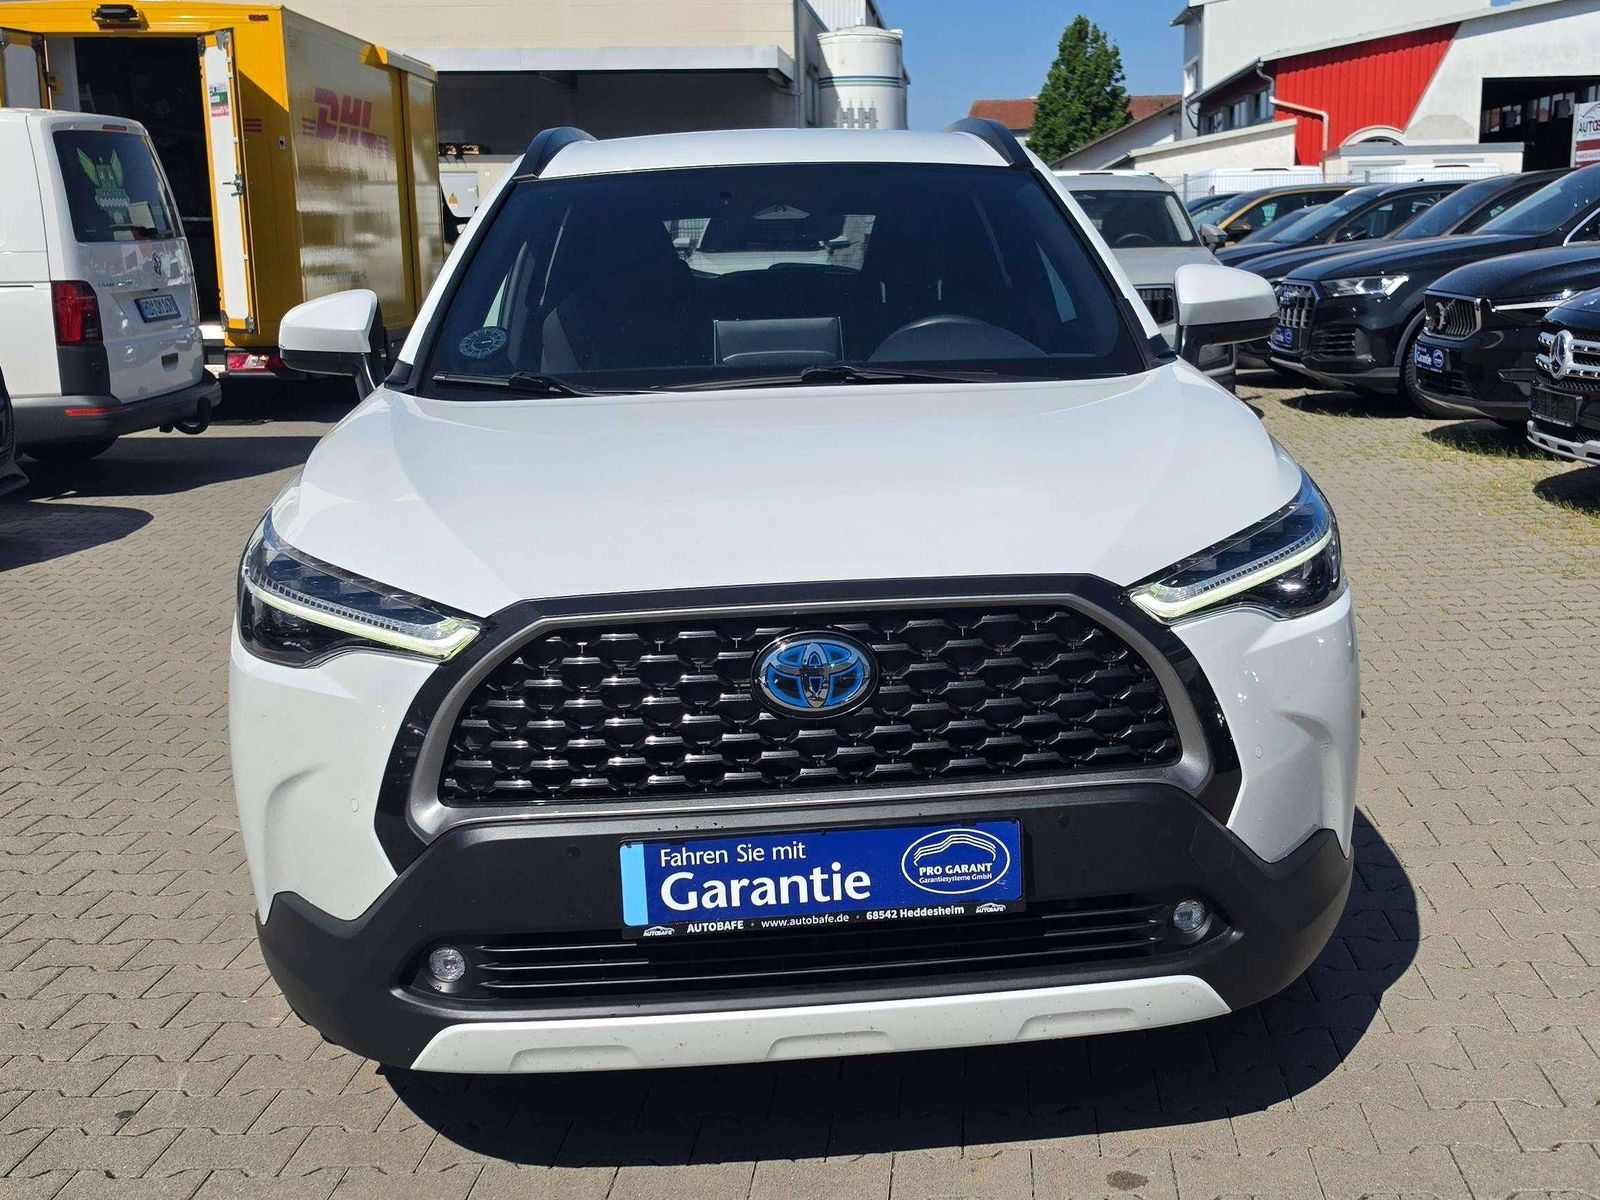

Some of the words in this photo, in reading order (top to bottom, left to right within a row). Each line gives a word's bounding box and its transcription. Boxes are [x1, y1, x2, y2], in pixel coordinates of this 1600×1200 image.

[314, 86, 378, 150] DHL
[660, 846, 729, 867] Fahren
[736, 843, 765, 862] Sie
[772, 840, 807, 860] mit
[918, 865, 943, 877] PRO
[945, 862, 993, 875] GARANT
[918, 874, 971, 884] Garantiesysteme
[660, 861, 871, 911] Garantie
[686, 920, 744, 934] AUTOBAFE
[760, 913, 850, 929] www.autobafe.de
[866, 909, 898, 921] 68542
[899, 905, 965, 919] Heddesheim
